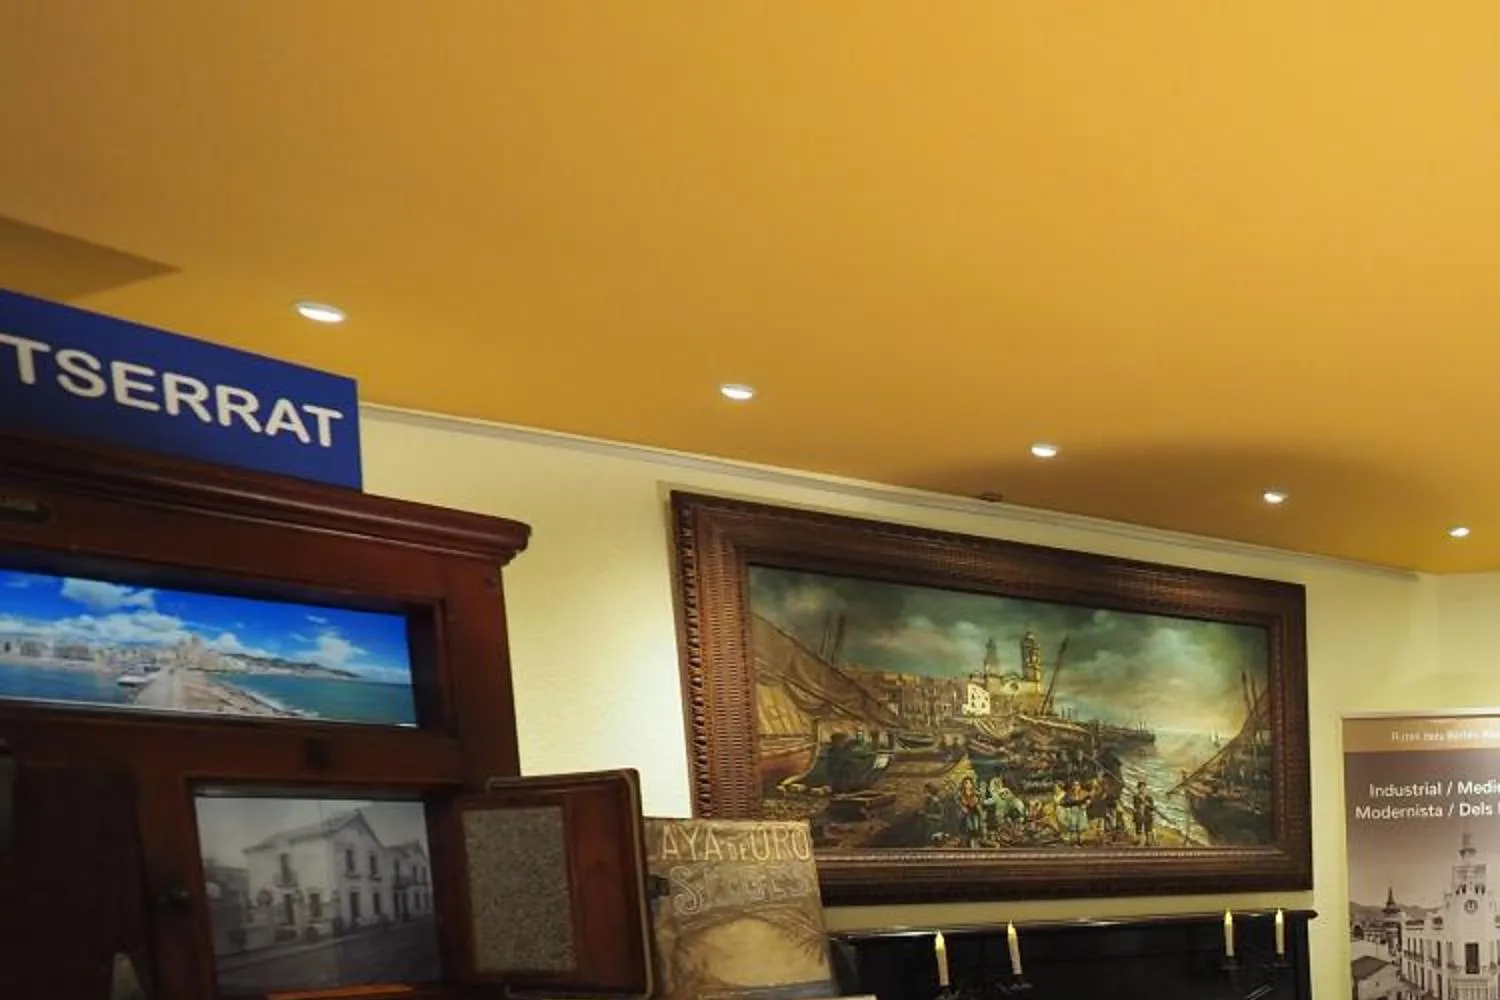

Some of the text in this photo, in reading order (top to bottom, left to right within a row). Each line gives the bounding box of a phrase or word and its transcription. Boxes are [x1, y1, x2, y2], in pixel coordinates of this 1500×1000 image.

[0, 333, 344, 448] TSERRAT
[1369, 782, 1442, 798] Industrial
[1355, 804, 1443, 820] Modernista
[1459, 802, 1493, 817] Dels
